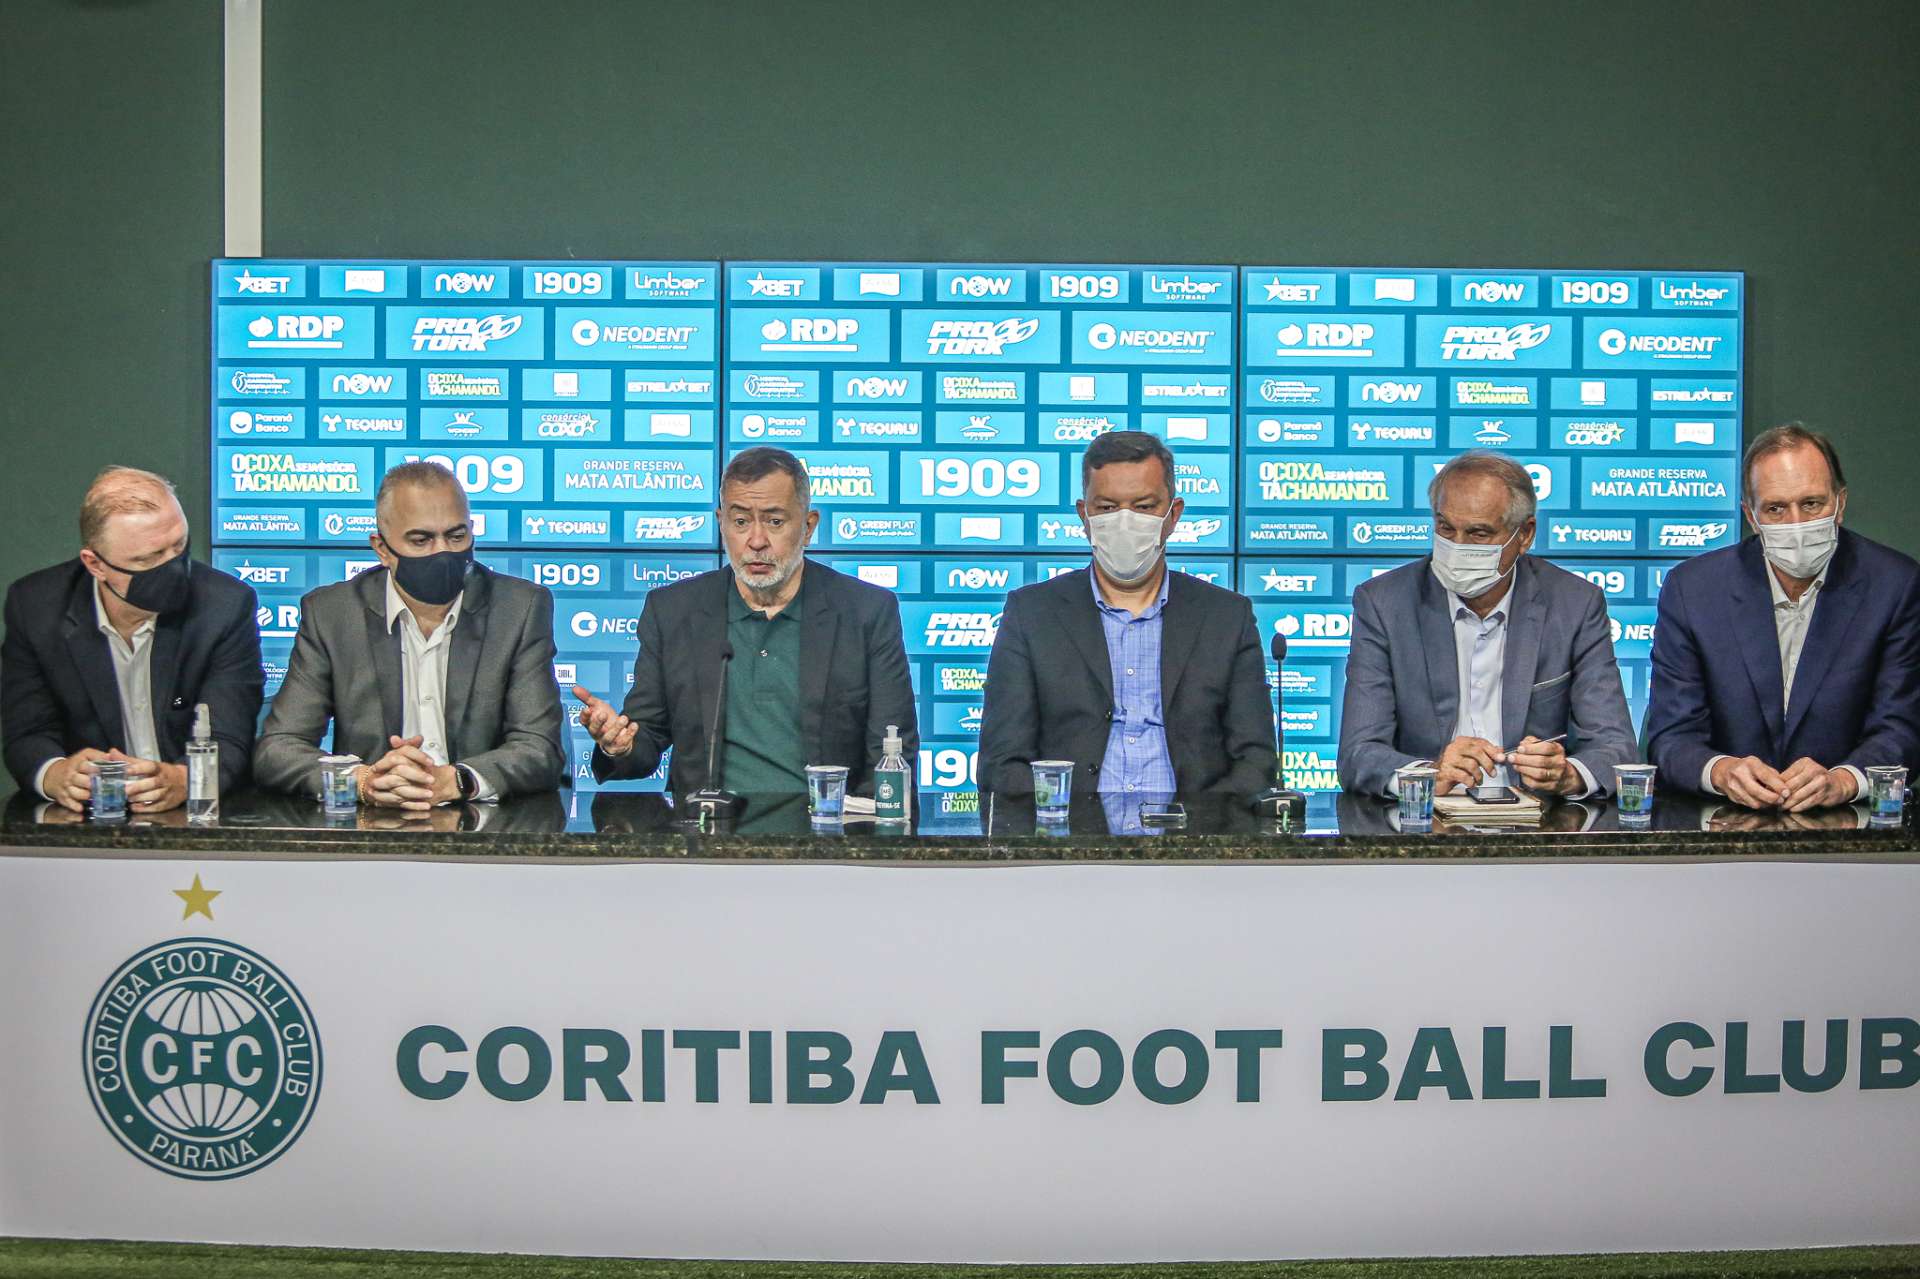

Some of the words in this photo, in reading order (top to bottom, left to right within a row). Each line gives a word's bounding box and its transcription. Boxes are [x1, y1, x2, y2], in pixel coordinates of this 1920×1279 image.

[252, 278, 289, 292] BET
[535, 272, 601, 294] 1909
[768, 280, 803, 296] BET
[1051, 276, 1118, 298] 1909
[1284, 285, 1320, 301] BET
[1563, 282, 1628, 303] 1909
[278, 316, 343, 338] RDP
[415, 318, 478, 334] PRO
[792, 319, 858, 341] RDP
[930, 322, 992, 337] PRO
[412, 334, 488, 351] TORK
[604, 327, 693, 342] NEODENT
[1120, 331, 1209, 346] NEODENT
[1308, 324, 1373, 346] RDP
[1444, 327, 1507, 343] PRO
[927, 337, 1004, 354] TORK
[1441, 343, 1516, 359] TORK
[1630, 337, 1716, 351] NEODENT
[256, 424, 288, 432] Banco
[1284, 432, 1317, 440] Banco
[584, 461, 629, 470] GRANDE
[634, 461, 683, 470] RESERVA
[1174, 464, 1202, 476] ERVA
[1610, 469, 1654, 478] GRANDE
[1659, 469, 1707, 478] RESERVA
[566, 474, 608, 488] MATA
[612, 472, 703, 489] ATLÂNTICA
[920, 459, 1040, 497] 1909
[1175, 478, 1221, 495] NTICA
[1592, 482, 1634, 496] MATA
[1638, 480, 1726, 496] ATLÂNTICA
[233, 514, 260, 522] GRANDE
[261, 514, 290, 522] RESERVA
[223, 522, 250, 532] MATA
[251, 521, 301, 532] ATLÂNTICA
[548, 522, 606, 534] TEQUALY
[1250, 530, 1277, 541] MATA
[1278, 529, 1329, 541] ATLÂNTICA
[1575, 530, 1631, 541] TEQUALY
[254, 568, 289, 582] BET
[534, 564, 599, 585] 1909
[1281, 576, 1316, 591] BET
[924, 611, 990, 630] PRO
[918, 749, 980, 787] 19
[95, 973, 152, 1093] CORITIBA
[151, 950, 225, 981] FOOT
[230, 959, 289, 1019] BALL
[282, 1022, 311, 1097] CLUB
[395, 1024, 942, 1105] CORITIBA
[980, 1028, 1283, 1105] FOOT
[1321, 1025, 1607, 1102] BALL
[1643, 1016, 1920, 1098] CLUB
[149, 1131, 259, 1169] PARANÁ
